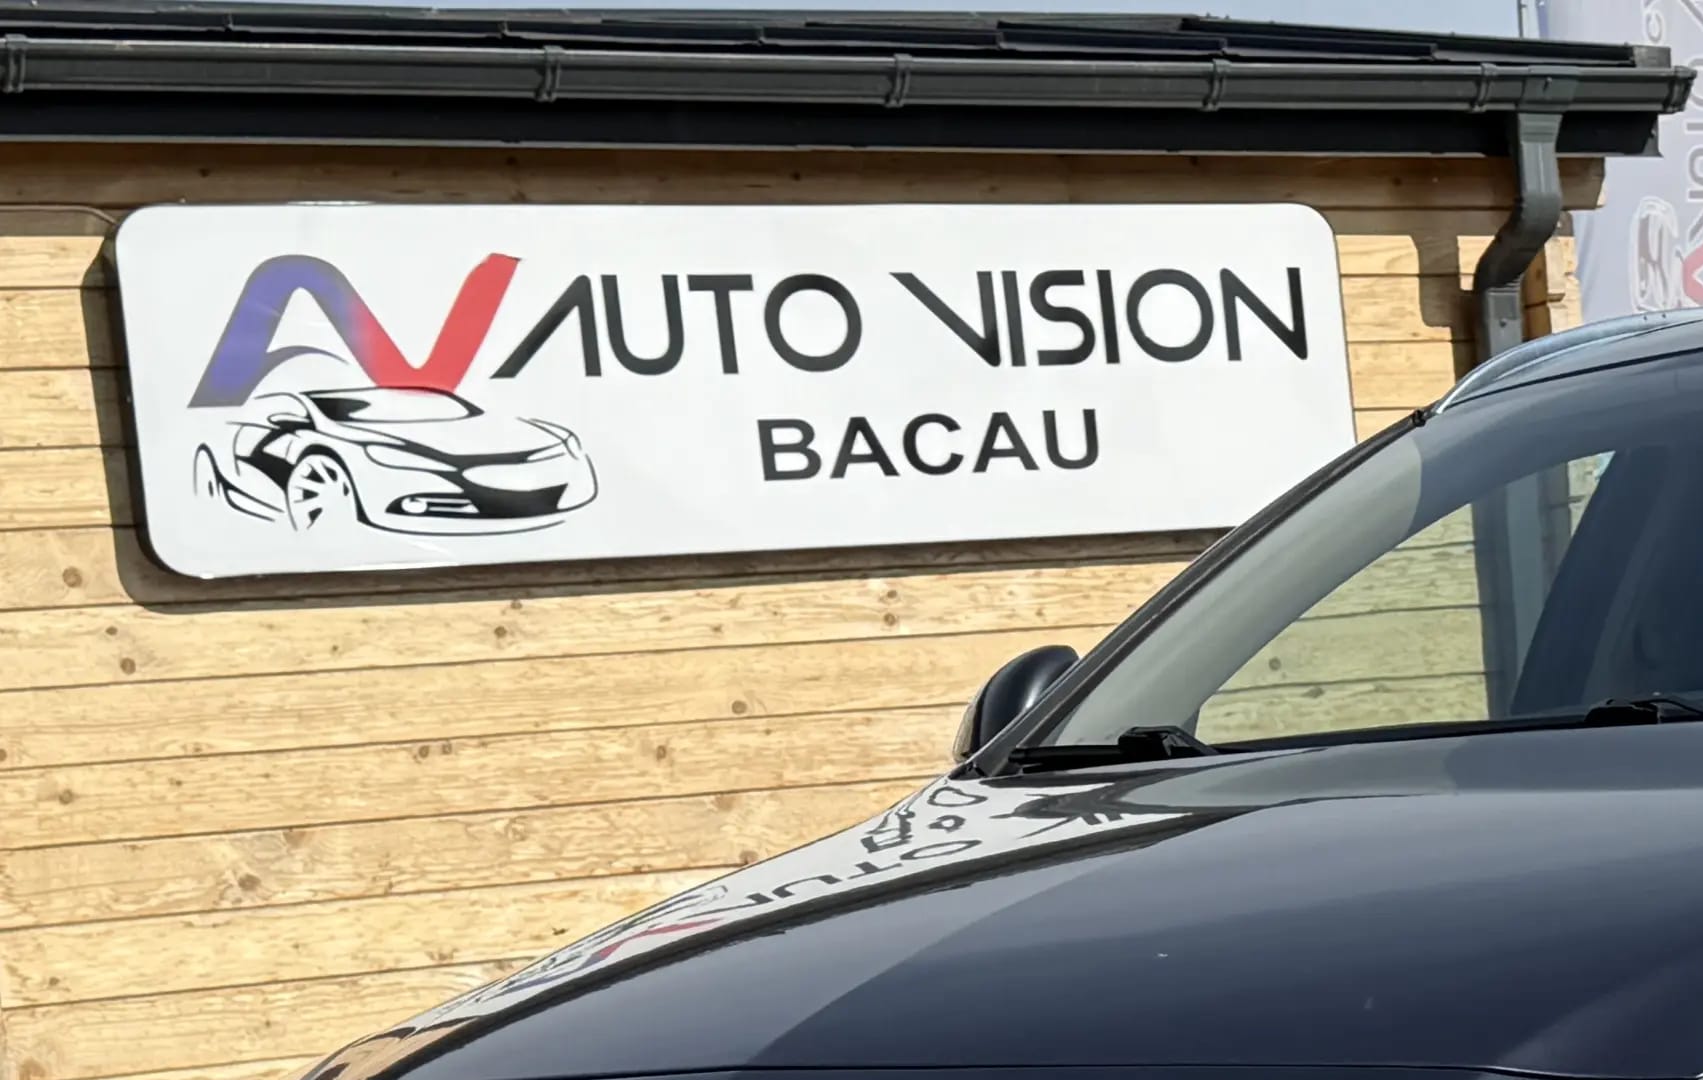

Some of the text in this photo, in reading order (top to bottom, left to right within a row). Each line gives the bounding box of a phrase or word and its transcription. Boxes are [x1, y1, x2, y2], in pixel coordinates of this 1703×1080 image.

[490, 267, 1308, 378] AUTO VISION
[757, 409, 1102, 482] BACAU
